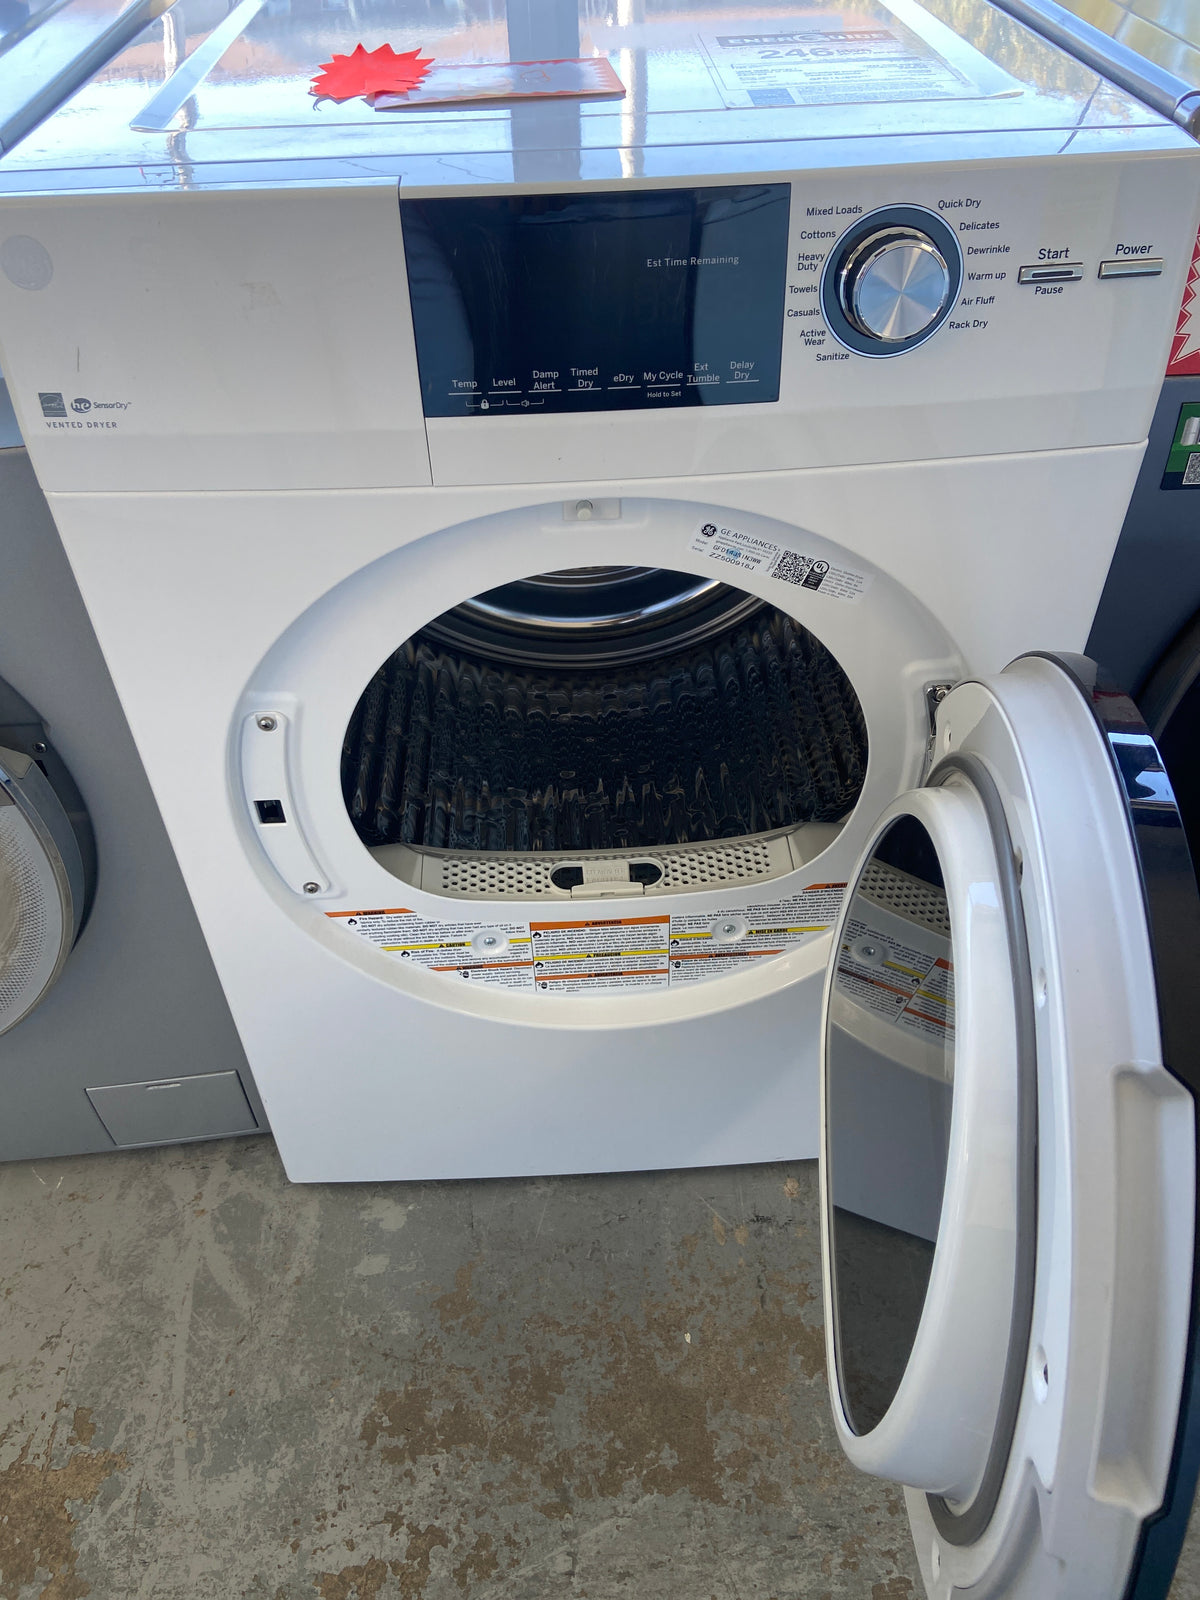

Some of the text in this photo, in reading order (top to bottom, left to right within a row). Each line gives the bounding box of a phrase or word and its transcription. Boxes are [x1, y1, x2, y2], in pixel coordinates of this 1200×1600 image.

[757, 47, 835, 59] 246
[938, 198, 982, 210] Quick Dry
[806, 205, 862, 216] Mixed Loads
[959, 221, 1000, 230] Delicates
[800, 230, 836, 240] Cottons
[967, 244, 1010, 255] Dewrinkle
[1038, 247, 1070, 260] Start
[1115, 244, 1153, 256] Power
[646, 256, 740, 268] Est Time Remaining
[798, 252, 826, 262] Heavy
[797, 262, 818, 272] Duty
[968, 272, 1006, 281] Warm up
[788, 284, 818, 294] Towels
[1034, 285, 1064, 295] Pause
[960, 296, 996, 306] Air Fluff
[787, 308, 820, 318] Casuals
[949, 320, 988, 330] Rack Dry
[800, 329, 826, 338] Active
[804, 338, 826, 346] Wear
[816, 352, 850, 362] Sanitize
[694, 362, 708, 372] Ext
[730, 360, 755, 371] Delay
[532, 370, 559, 380] Damp
[570, 368, 598, 378] Timed
[643, 370, 684, 382] My Cycle
[687, 373, 720, 383] Tumble
[734, 371, 750, 380] Dry
[492, 378, 516, 387] Level
[613, 374, 634, 384] eDry
[452, 380, 478, 390] Temp
[532, 380, 556, 390] Alert
[578, 379, 594, 390] Dry
[720, 528, 732, 538] GE
